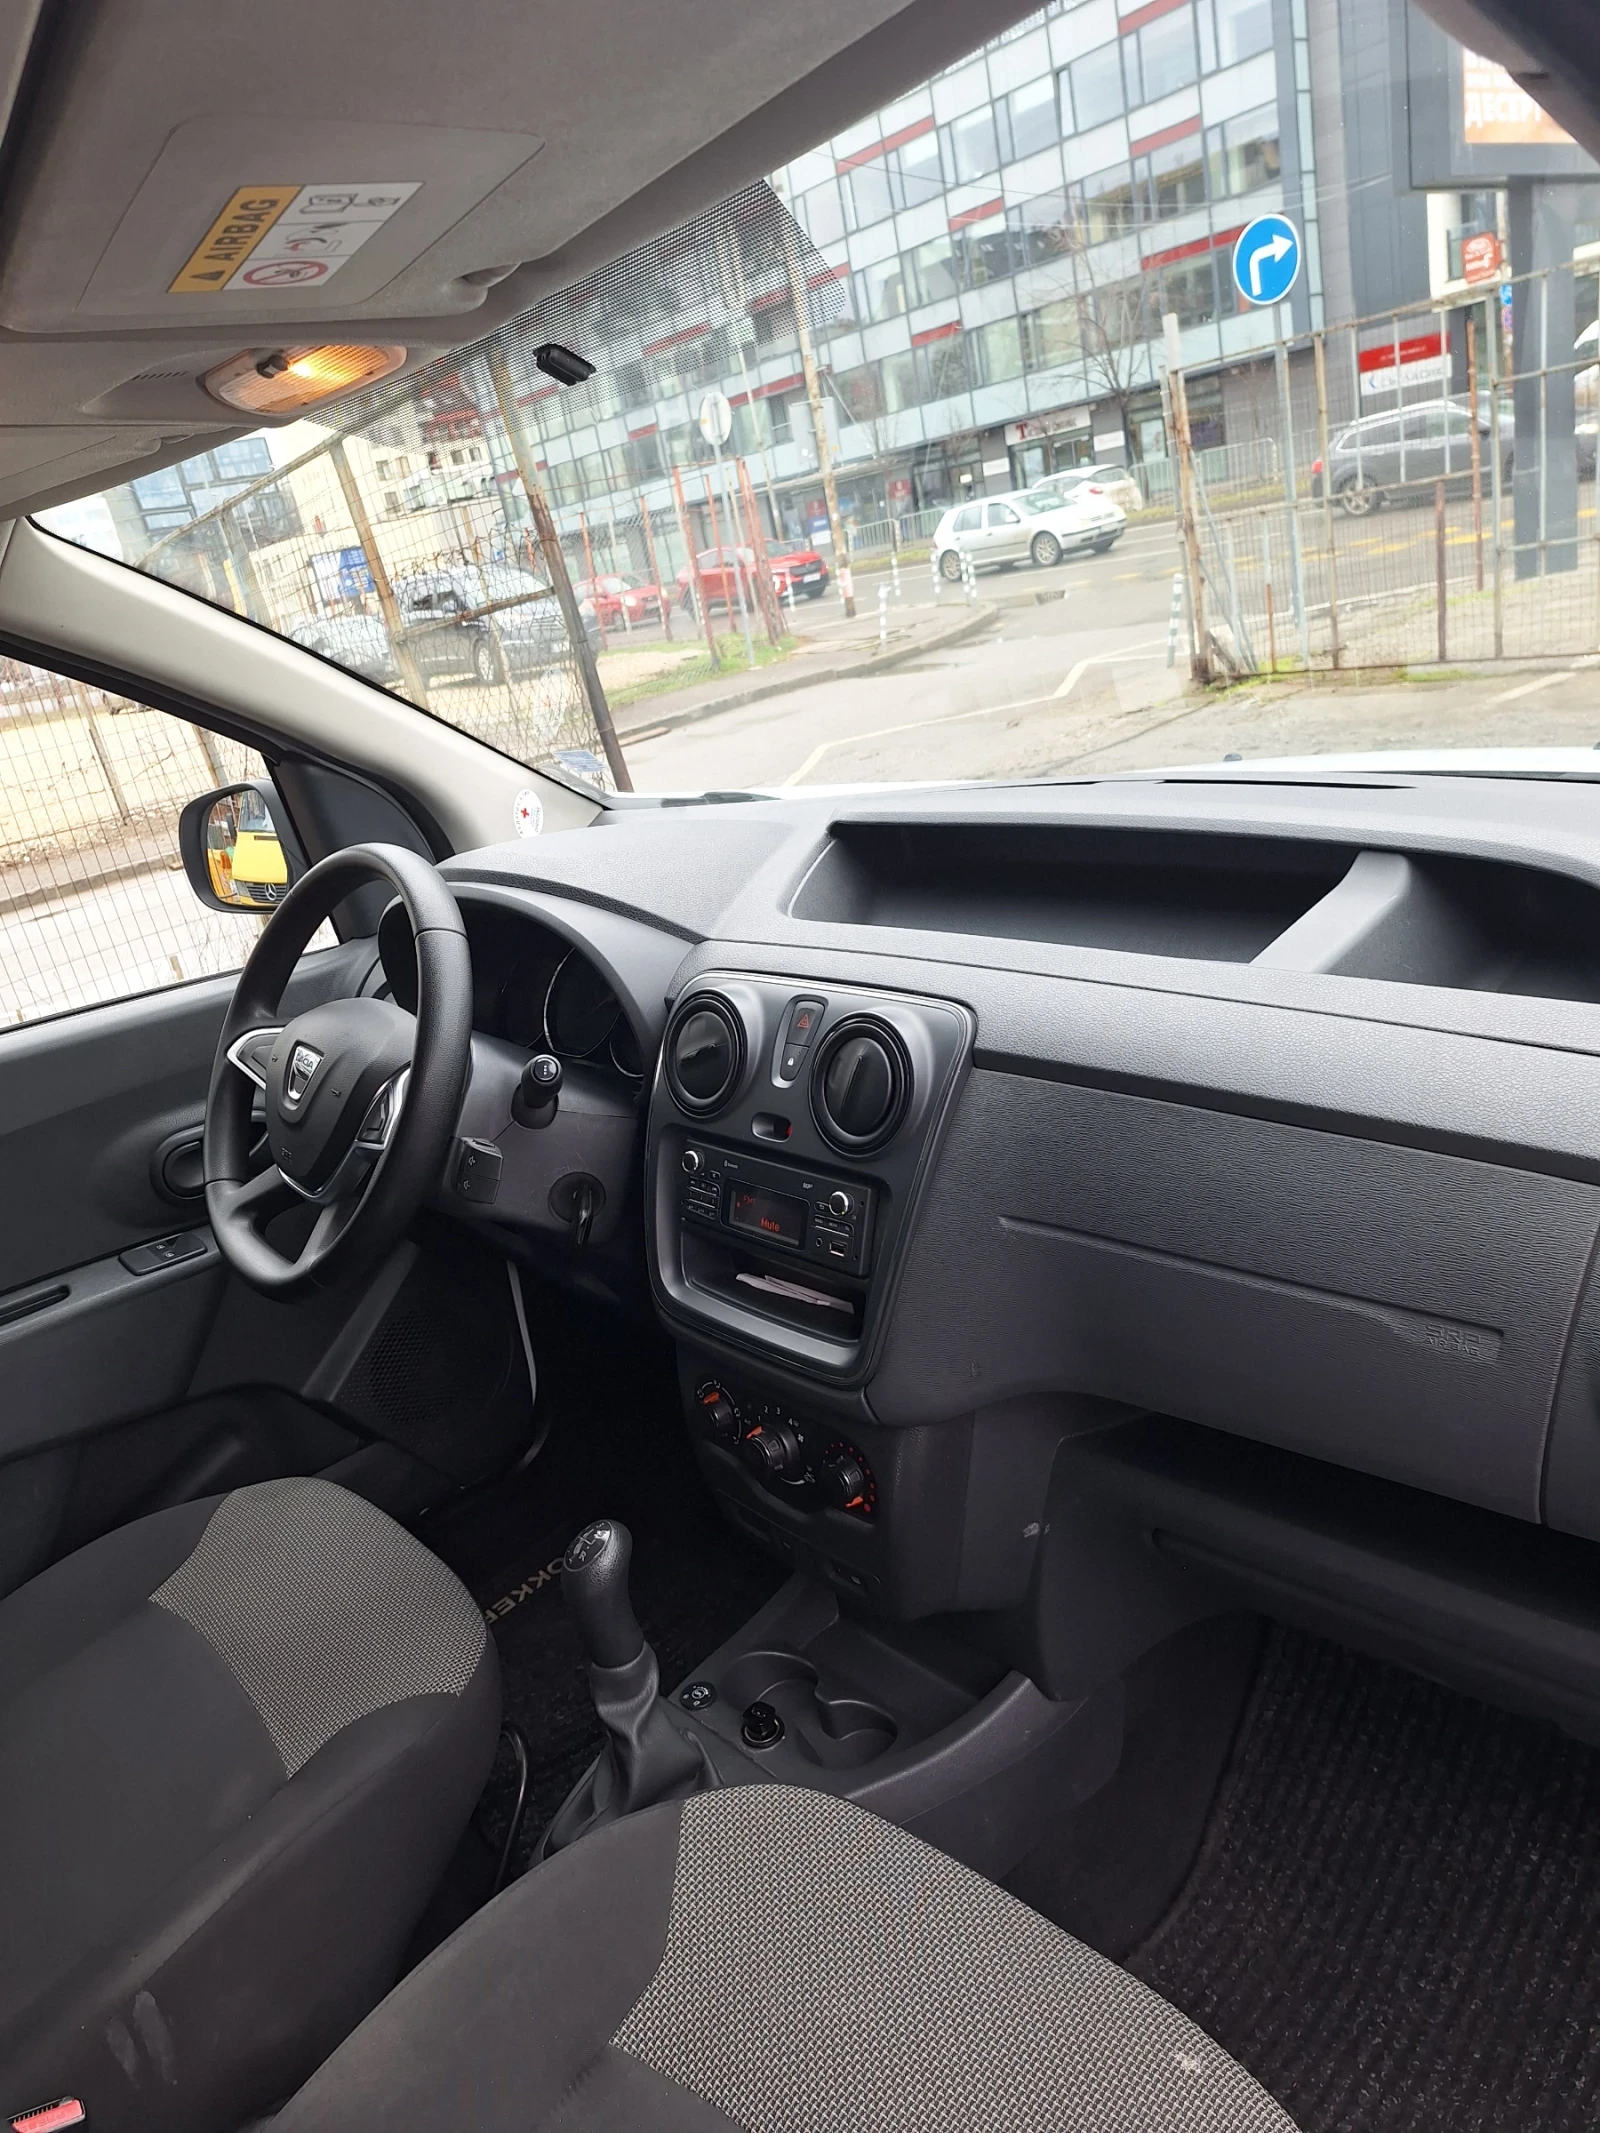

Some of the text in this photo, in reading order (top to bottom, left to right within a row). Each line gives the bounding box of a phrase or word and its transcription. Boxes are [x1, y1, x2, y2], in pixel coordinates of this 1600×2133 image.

[204, 198, 281, 261] AIRBAG
[764, 1406, 769, 1414] 2
[777, 1407, 781, 1415] 3
[579, 1550, 586, 1562] R
[485, 1557, 565, 1624] OKKER
